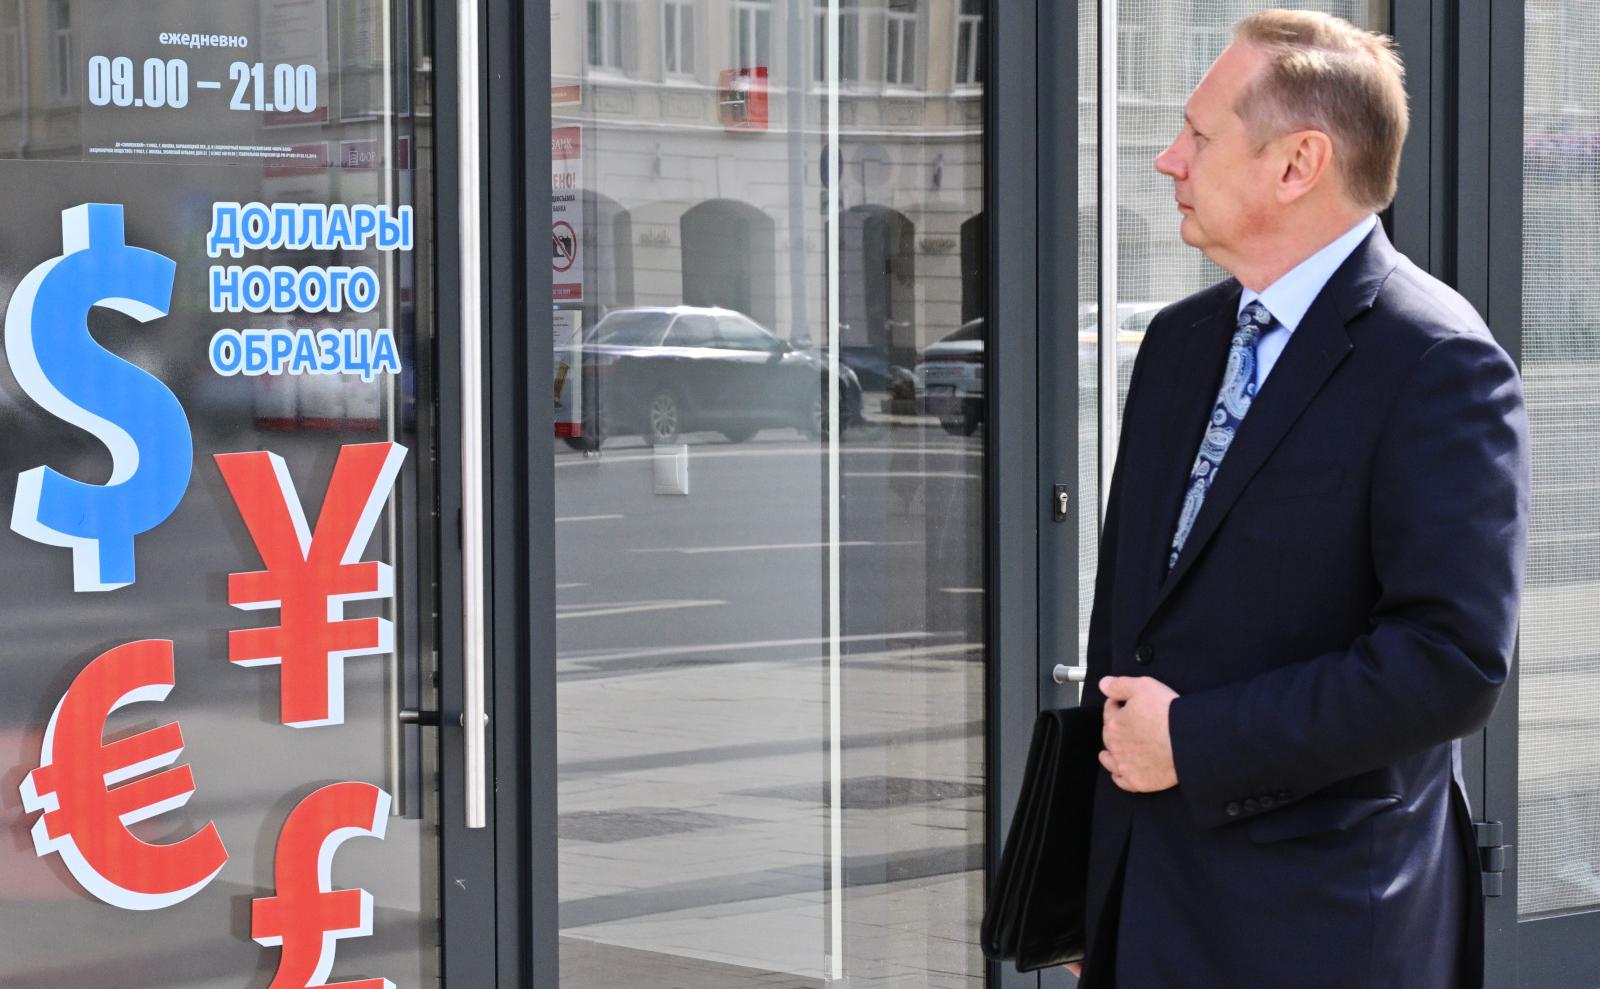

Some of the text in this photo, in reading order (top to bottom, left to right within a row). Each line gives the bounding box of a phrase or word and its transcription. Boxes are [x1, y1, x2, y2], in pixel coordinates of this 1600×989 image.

[159, 32, 248, 48] ежедневно
[88, 55, 189, 109] 09.00
[229, 61, 317, 113] 21.00
[206, 203, 413, 257] ДОЛЛАРЫ
[208, 266, 379, 313] НОВОГО
[209, 329, 402, 382] ОБРАЗЦА
